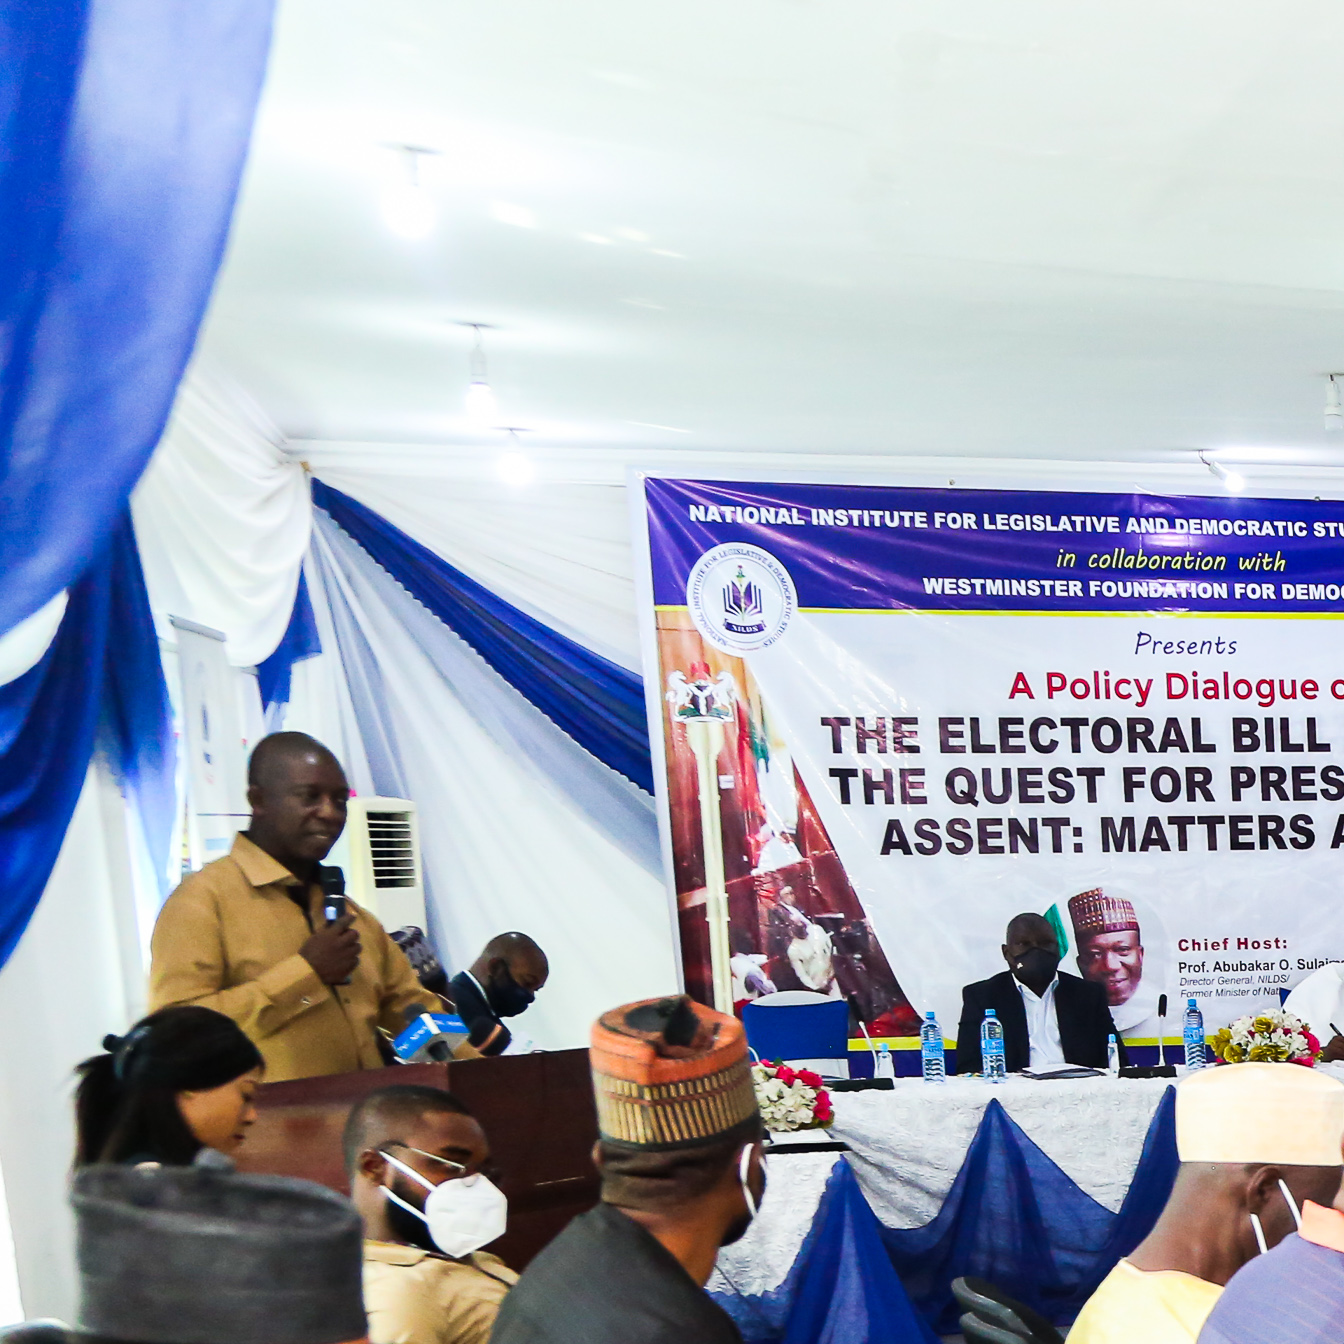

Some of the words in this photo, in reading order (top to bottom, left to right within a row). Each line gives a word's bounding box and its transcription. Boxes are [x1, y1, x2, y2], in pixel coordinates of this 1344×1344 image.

[689, 505, 805, 526] NATIONAL
[810, 507, 928, 529] INSTITUTE
[934, 511, 978, 531] FOR
[983, 512, 1121, 535] LEGISLATIVE
[1126, 517, 1170, 535] AND
[1175, 519, 1308, 539] DEMOCRATIC
[704, 554, 719, 569] FOR
[1056, 547, 1076, 568] in
[1087, 549, 1227, 571] collaboration
[1238, 552, 1287, 572] with
[923, 577, 1084, 598] WESTMINSTER
[1089, 580, 1229, 600] FOUNDATION
[1233, 583, 1277, 600] FOR
[1135, 631, 1238, 656] Presents
[1008, 672, 1035, 700] A
[1046, 671, 1154, 708] Policy
[1165, 671, 1319, 708] Dialogue
[820, 716, 921, 755] THE
[939, 716, 1217, 754] ELECTORAL
[1232, 716, 1331, 753] BILL
[828, 767, 927, 805] THE
[944, 766, 1106, 808] QUEST
[1123, 766, 1214, 803] FOR
[879, 818, 1084, 857] ASSENT:
[1101, 814, 1316, 855] MATTERS
[1177, 938, 1230, 951] Chief
[1236, 937, 1288, 951] Host:
[1178, 961, 1210, 974] Prof.
[1212, 959, 1276, 973] Abubakar
[1278, 958, 1293, 971] O.
[1179, 976, 1215, 987] Director
[1217, 975, 1255, 986] General,
[1180, 988, 1213, 998] Former
[1215, 987, 1250, 998] Minister
[1252, 986, 1261, 997] of
